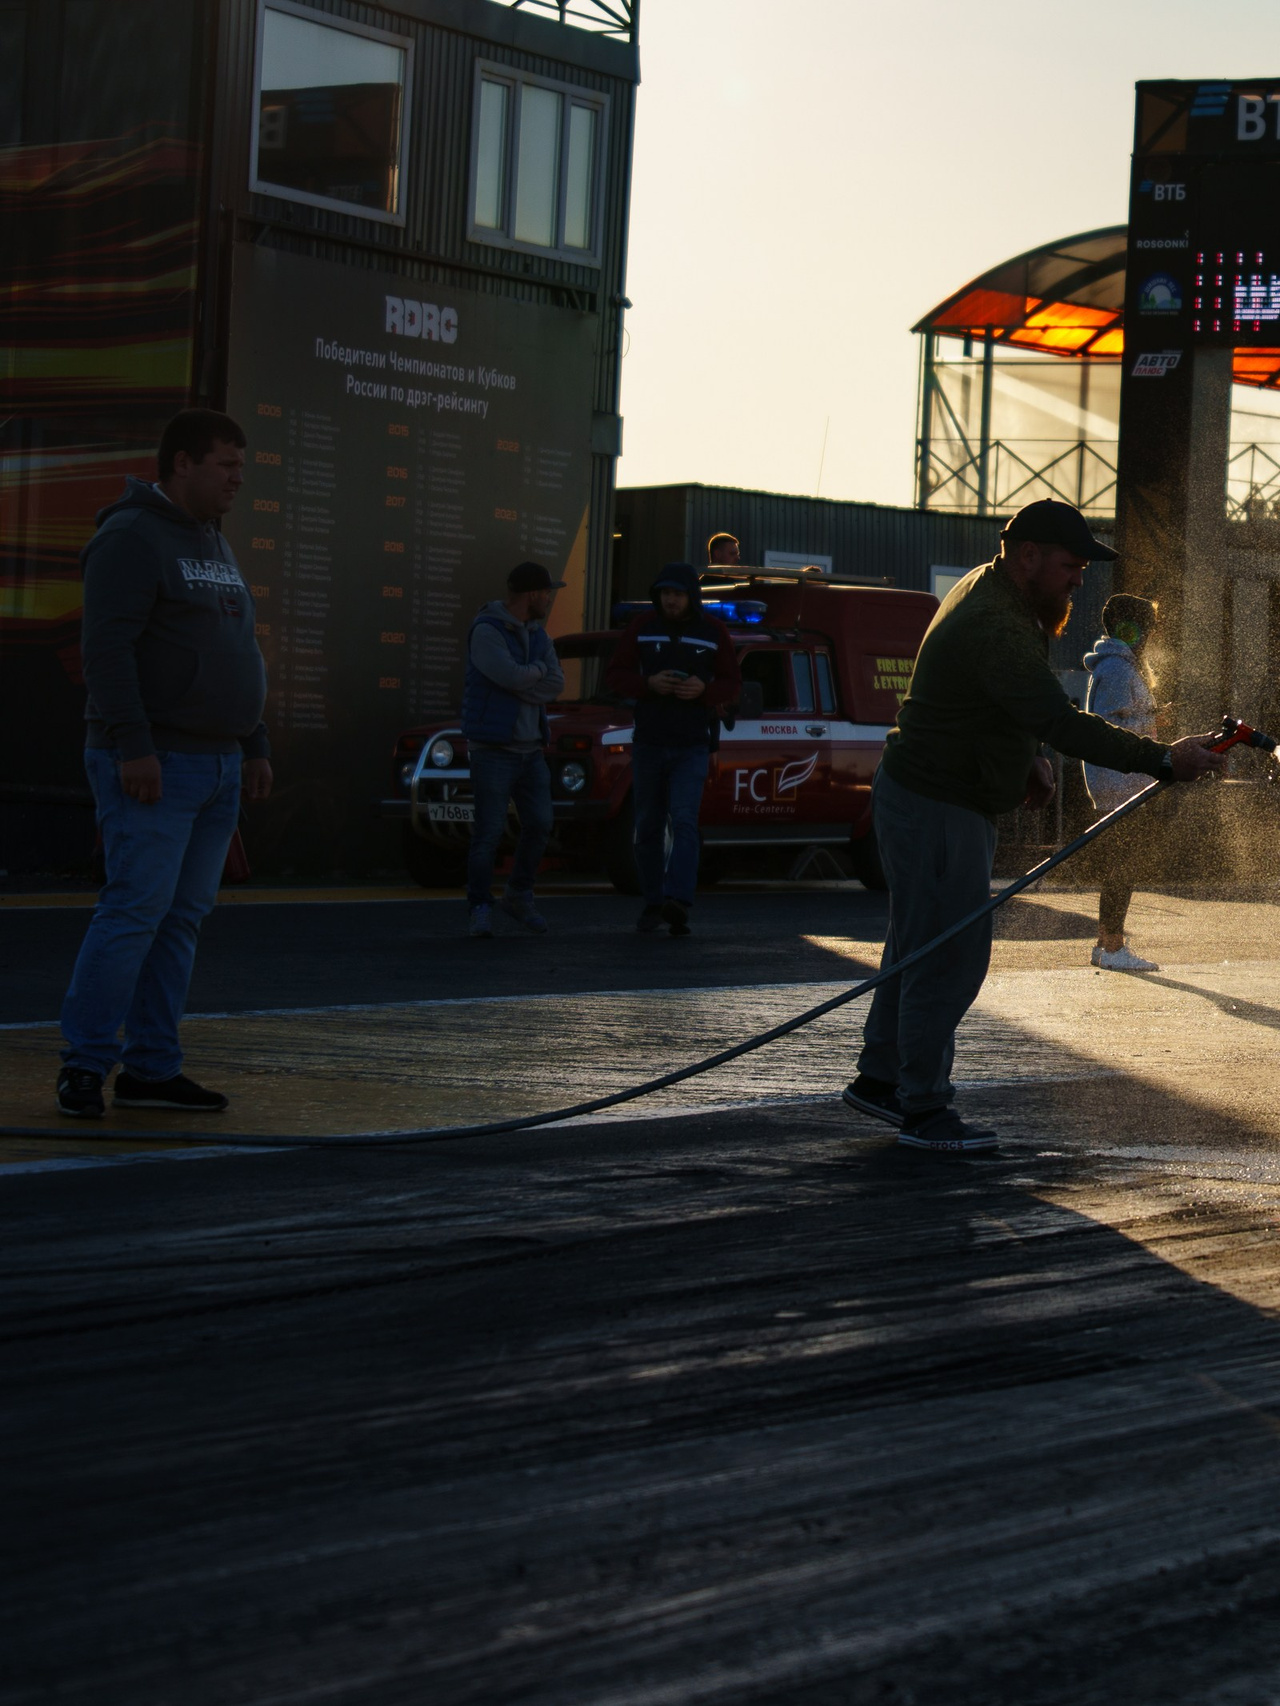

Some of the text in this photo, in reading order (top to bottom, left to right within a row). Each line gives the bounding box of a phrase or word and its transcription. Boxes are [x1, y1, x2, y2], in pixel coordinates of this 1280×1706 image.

[1154, 183, 1187, 201] ВТБ
[1136, 239, 1189, 249] ROSGONKI
[384, 295, 459, 345] RDRC
[315, 337, 516, 391] Победители Чемпионатов и Кубков
[1138, 356, 1178, 367] АВТО
[346, 374, 489, 420] России по дрэг-рейсингу
[257, 403, 282, 418] 2005
[387, 423, 410, 438] 2015
[255, 450, 282, 467] 2008
[253, 498, 280, 513] 2009
[385, 496, 406, 508] 2017
[251, 537, 275, 551] 2010
[876, 658, 897, 673] FIRE
[880, 675, 911, 690] EXTRI
[761, 725, 798, 735] МОСКВА
[734, 768, 768, 802] FC
[732, 804, 796, 815] Fire-Center.ru
